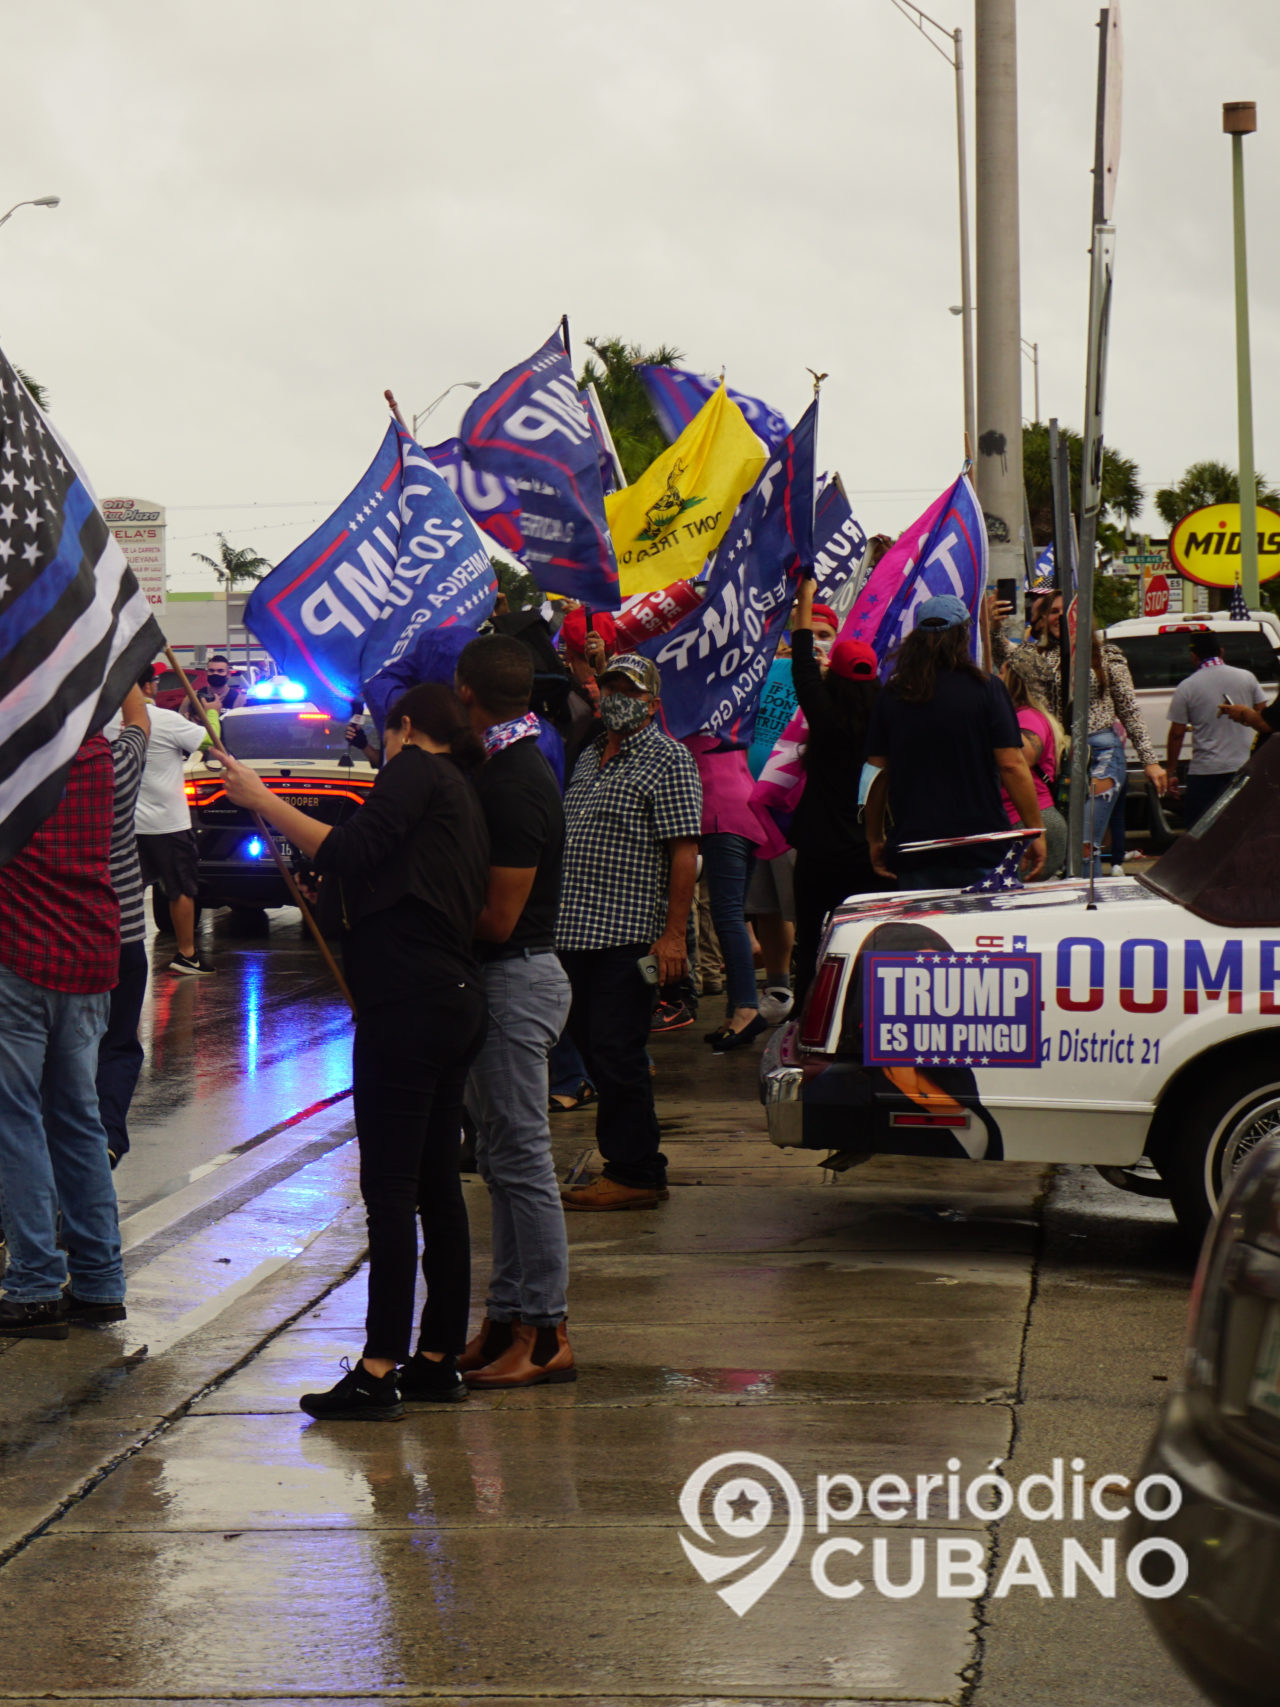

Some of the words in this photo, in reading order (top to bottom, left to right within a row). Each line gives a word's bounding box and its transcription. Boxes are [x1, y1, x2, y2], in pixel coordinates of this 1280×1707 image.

[103, 500, 134, 510] one
[122, 509, 160, 521] Plaza
[113, 529, 157, 539] ELA'S
[1184, 521, 1280, 560] MIDS
[648, 589, 682, 618] ORE
[1145, 590, 1168, 612] STOP
[769, 707, 793, 721] LIK
[1041, 936, 1280, 1015] OOM
[877, 967, 1030, 1017] TRUMP
[880, 1023, 908, 1051] ES
[913, 1023, 948, 1053] UN
[953, 1023, 1028, 1054] PINGU
[1058, 1028, 1135, 1065] District
[1141, 1038, 1161, 1065] 21
